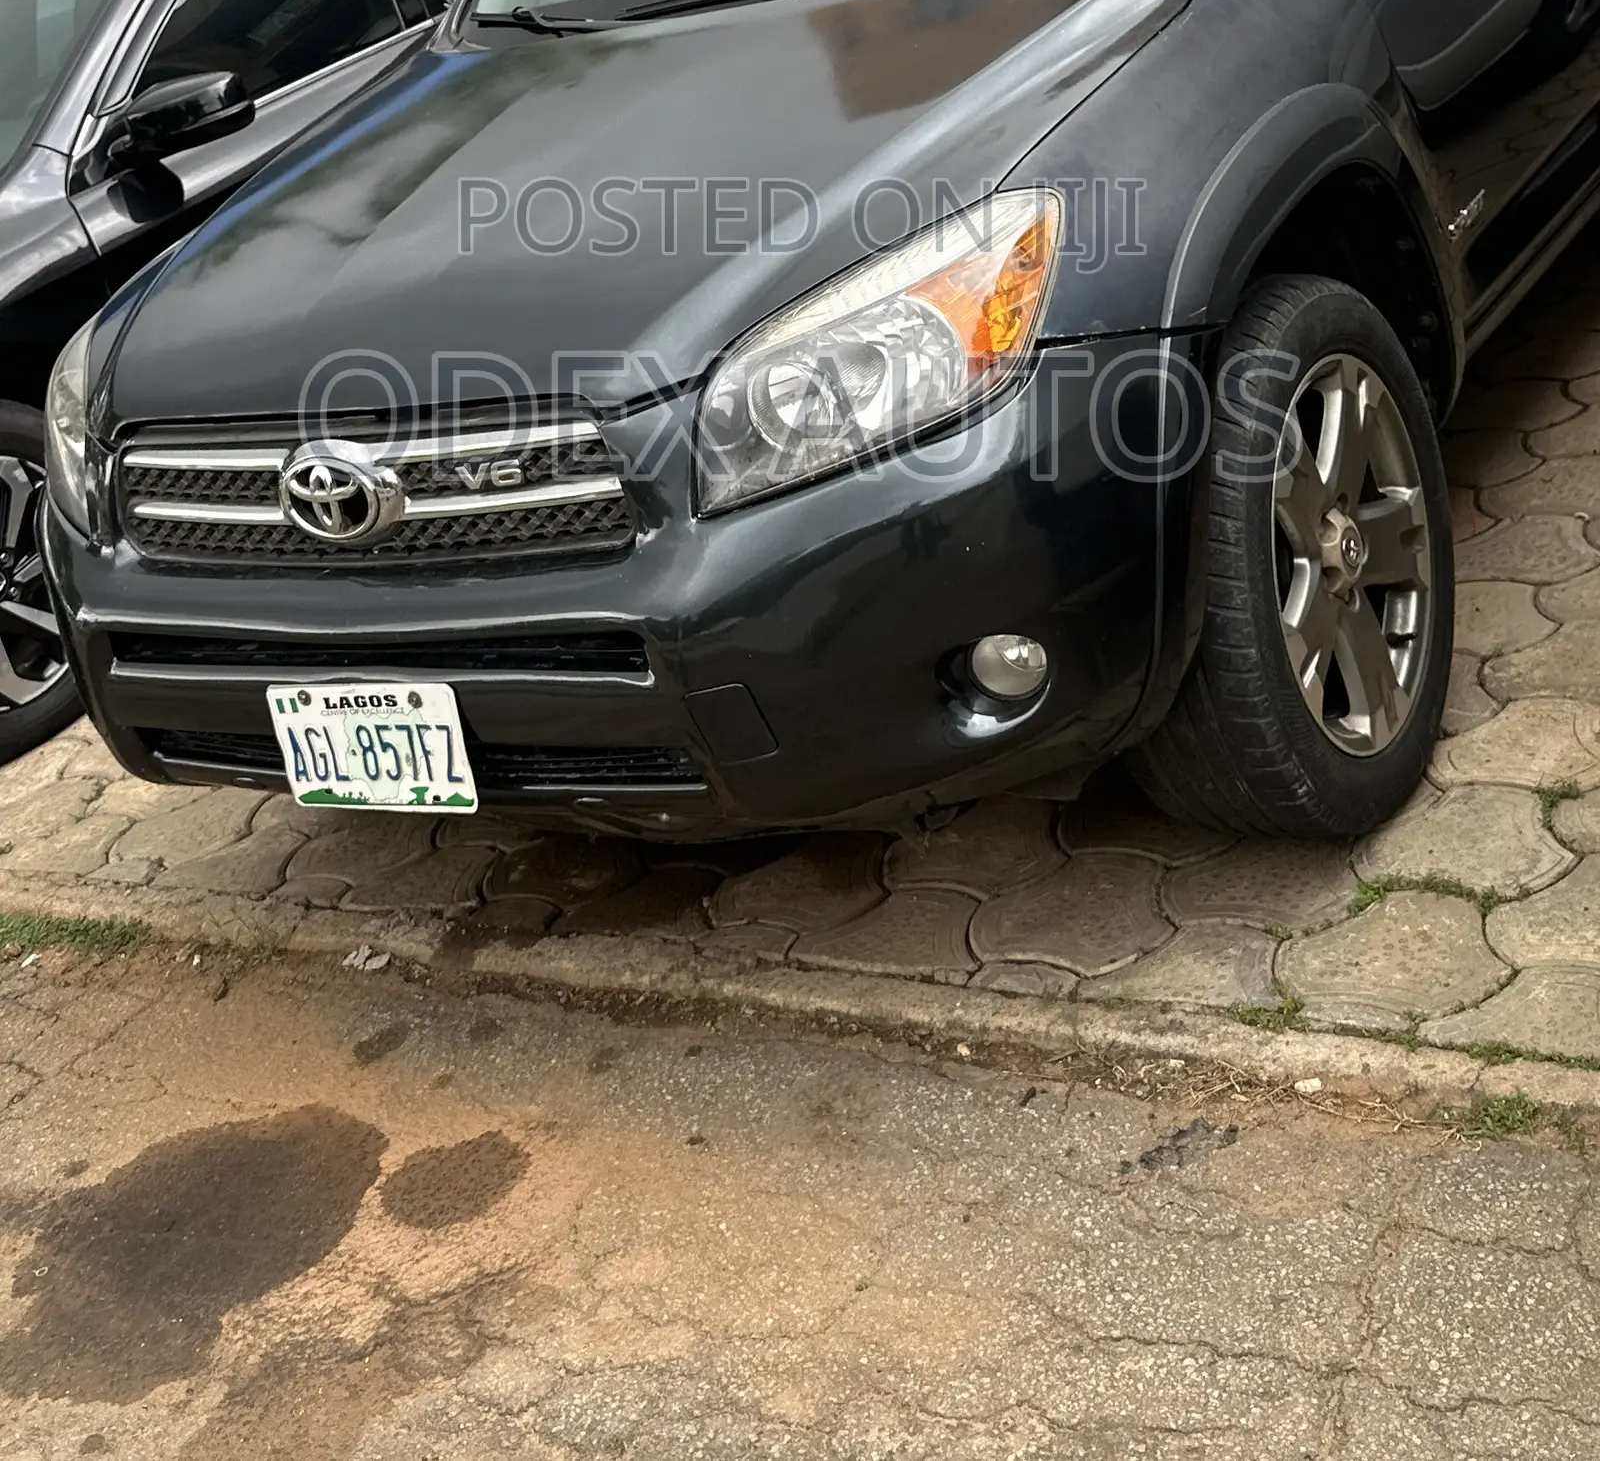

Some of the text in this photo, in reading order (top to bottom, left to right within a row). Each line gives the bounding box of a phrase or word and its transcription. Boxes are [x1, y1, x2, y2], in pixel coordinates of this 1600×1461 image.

[454, 458, 525, 490] V6
[322, 694, 398, 710] LAGOS
[287, 723, 465, 783] AGL 857FZ
